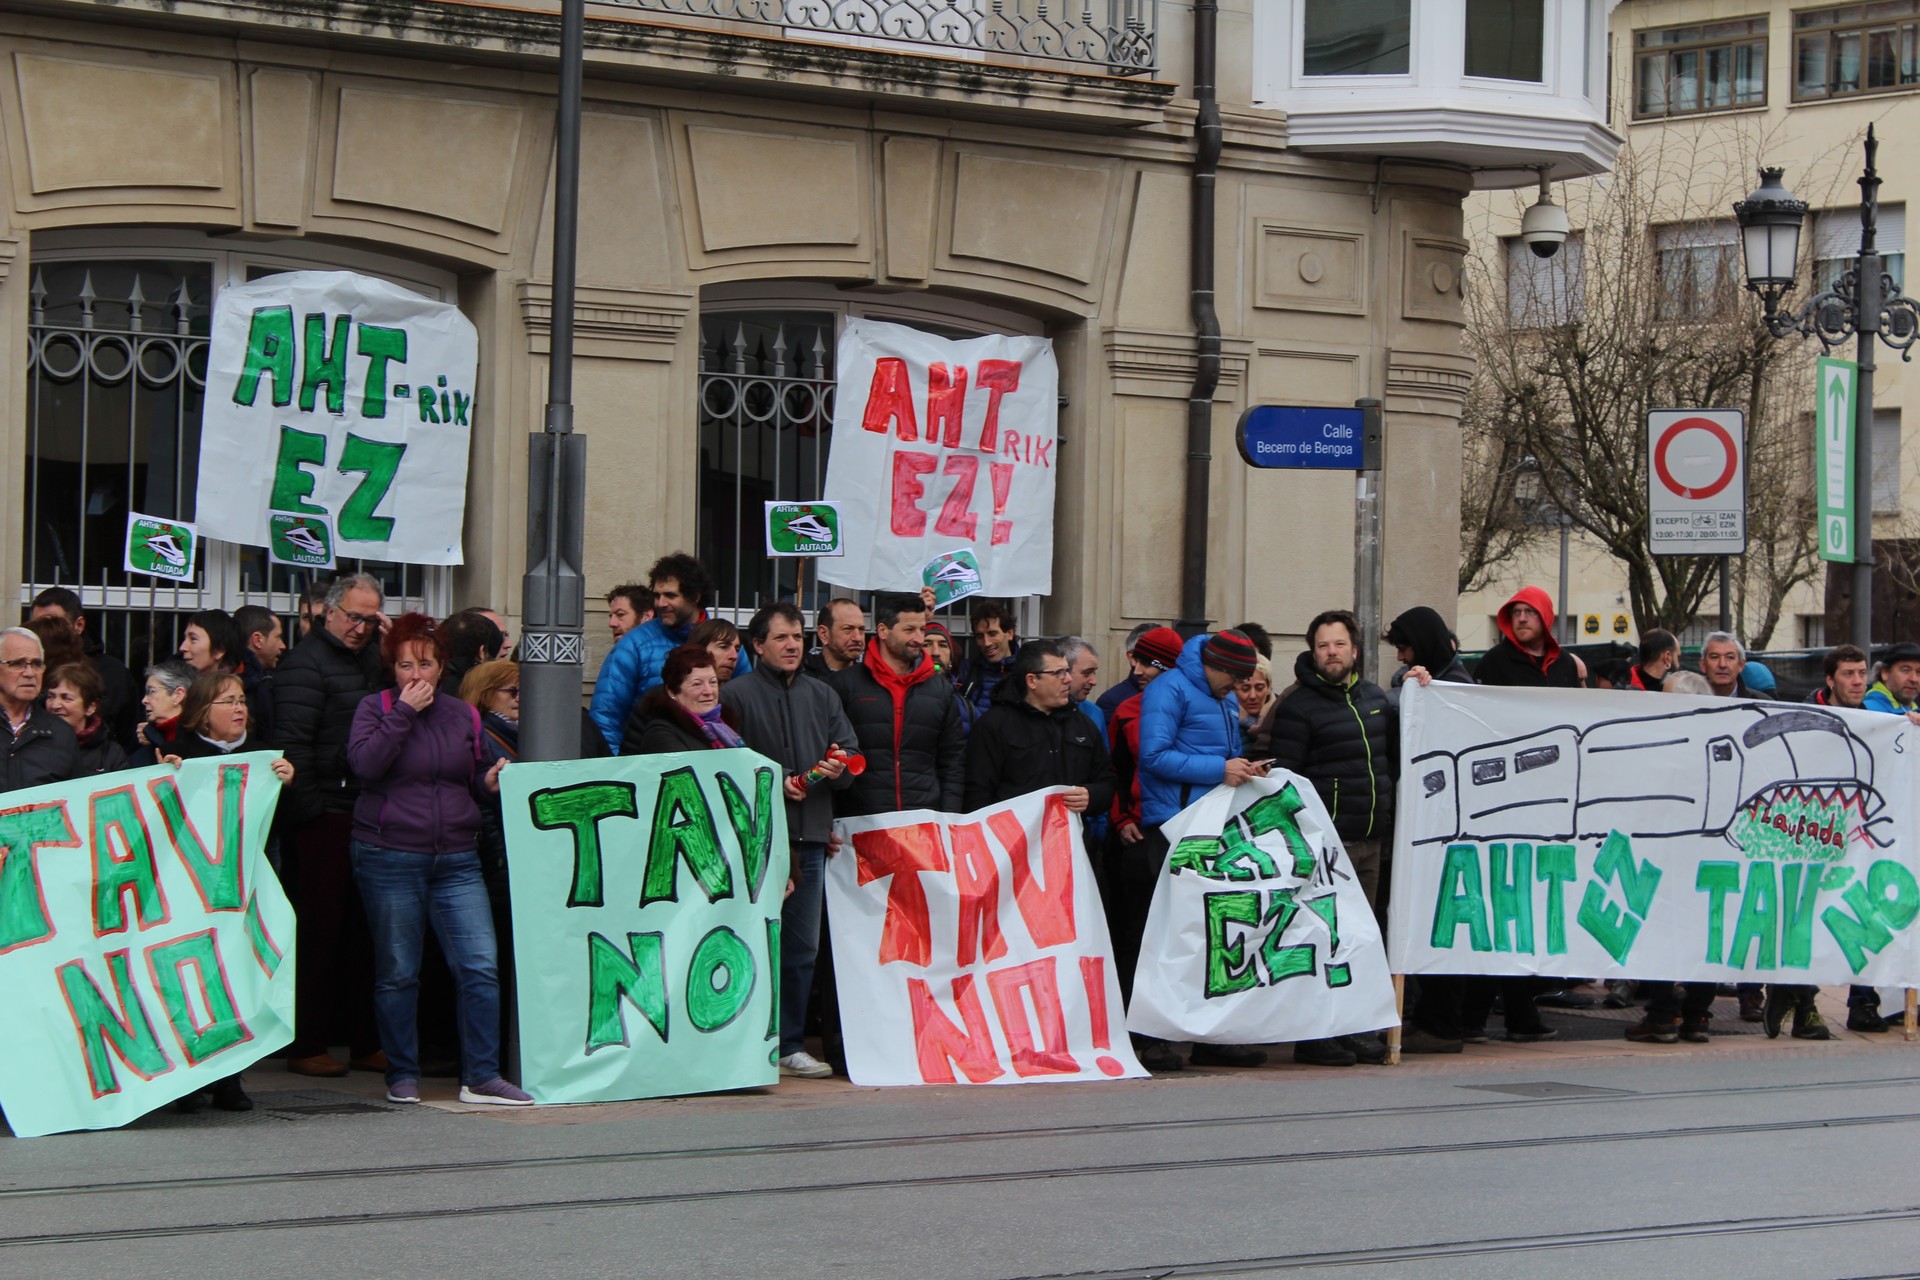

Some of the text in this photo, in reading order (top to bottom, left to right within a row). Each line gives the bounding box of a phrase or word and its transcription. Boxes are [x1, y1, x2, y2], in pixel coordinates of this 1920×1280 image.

[861, 357, 1053, 468] AHT RIK
[1257, 441, 1353, 457] Becerro de Bengoa
[1323, 424, 1353, 438] Calle
[138, 519, 160, 530] AHTrik
[269, 425, 407, 542] EZ
[890, 450, 1014, 546] EZ!
[150, 562, 185, 576] LAUTADA
[292, 554, 327, 564] LAUTADA
[794, 543, 833, 552] LAUTADA
[949, 582, 981, 598] LAUTAD
[0, 763, 250, 956] TAV
[528, 766, 775, 908] TAV
[852, 793, 1077, 968] TAV
[1430, 829, 1920, 976] AHT EZ TAV NO
[585, 917, 780, 1067] NO!
[907, 956, 1125, 1084] NO!
